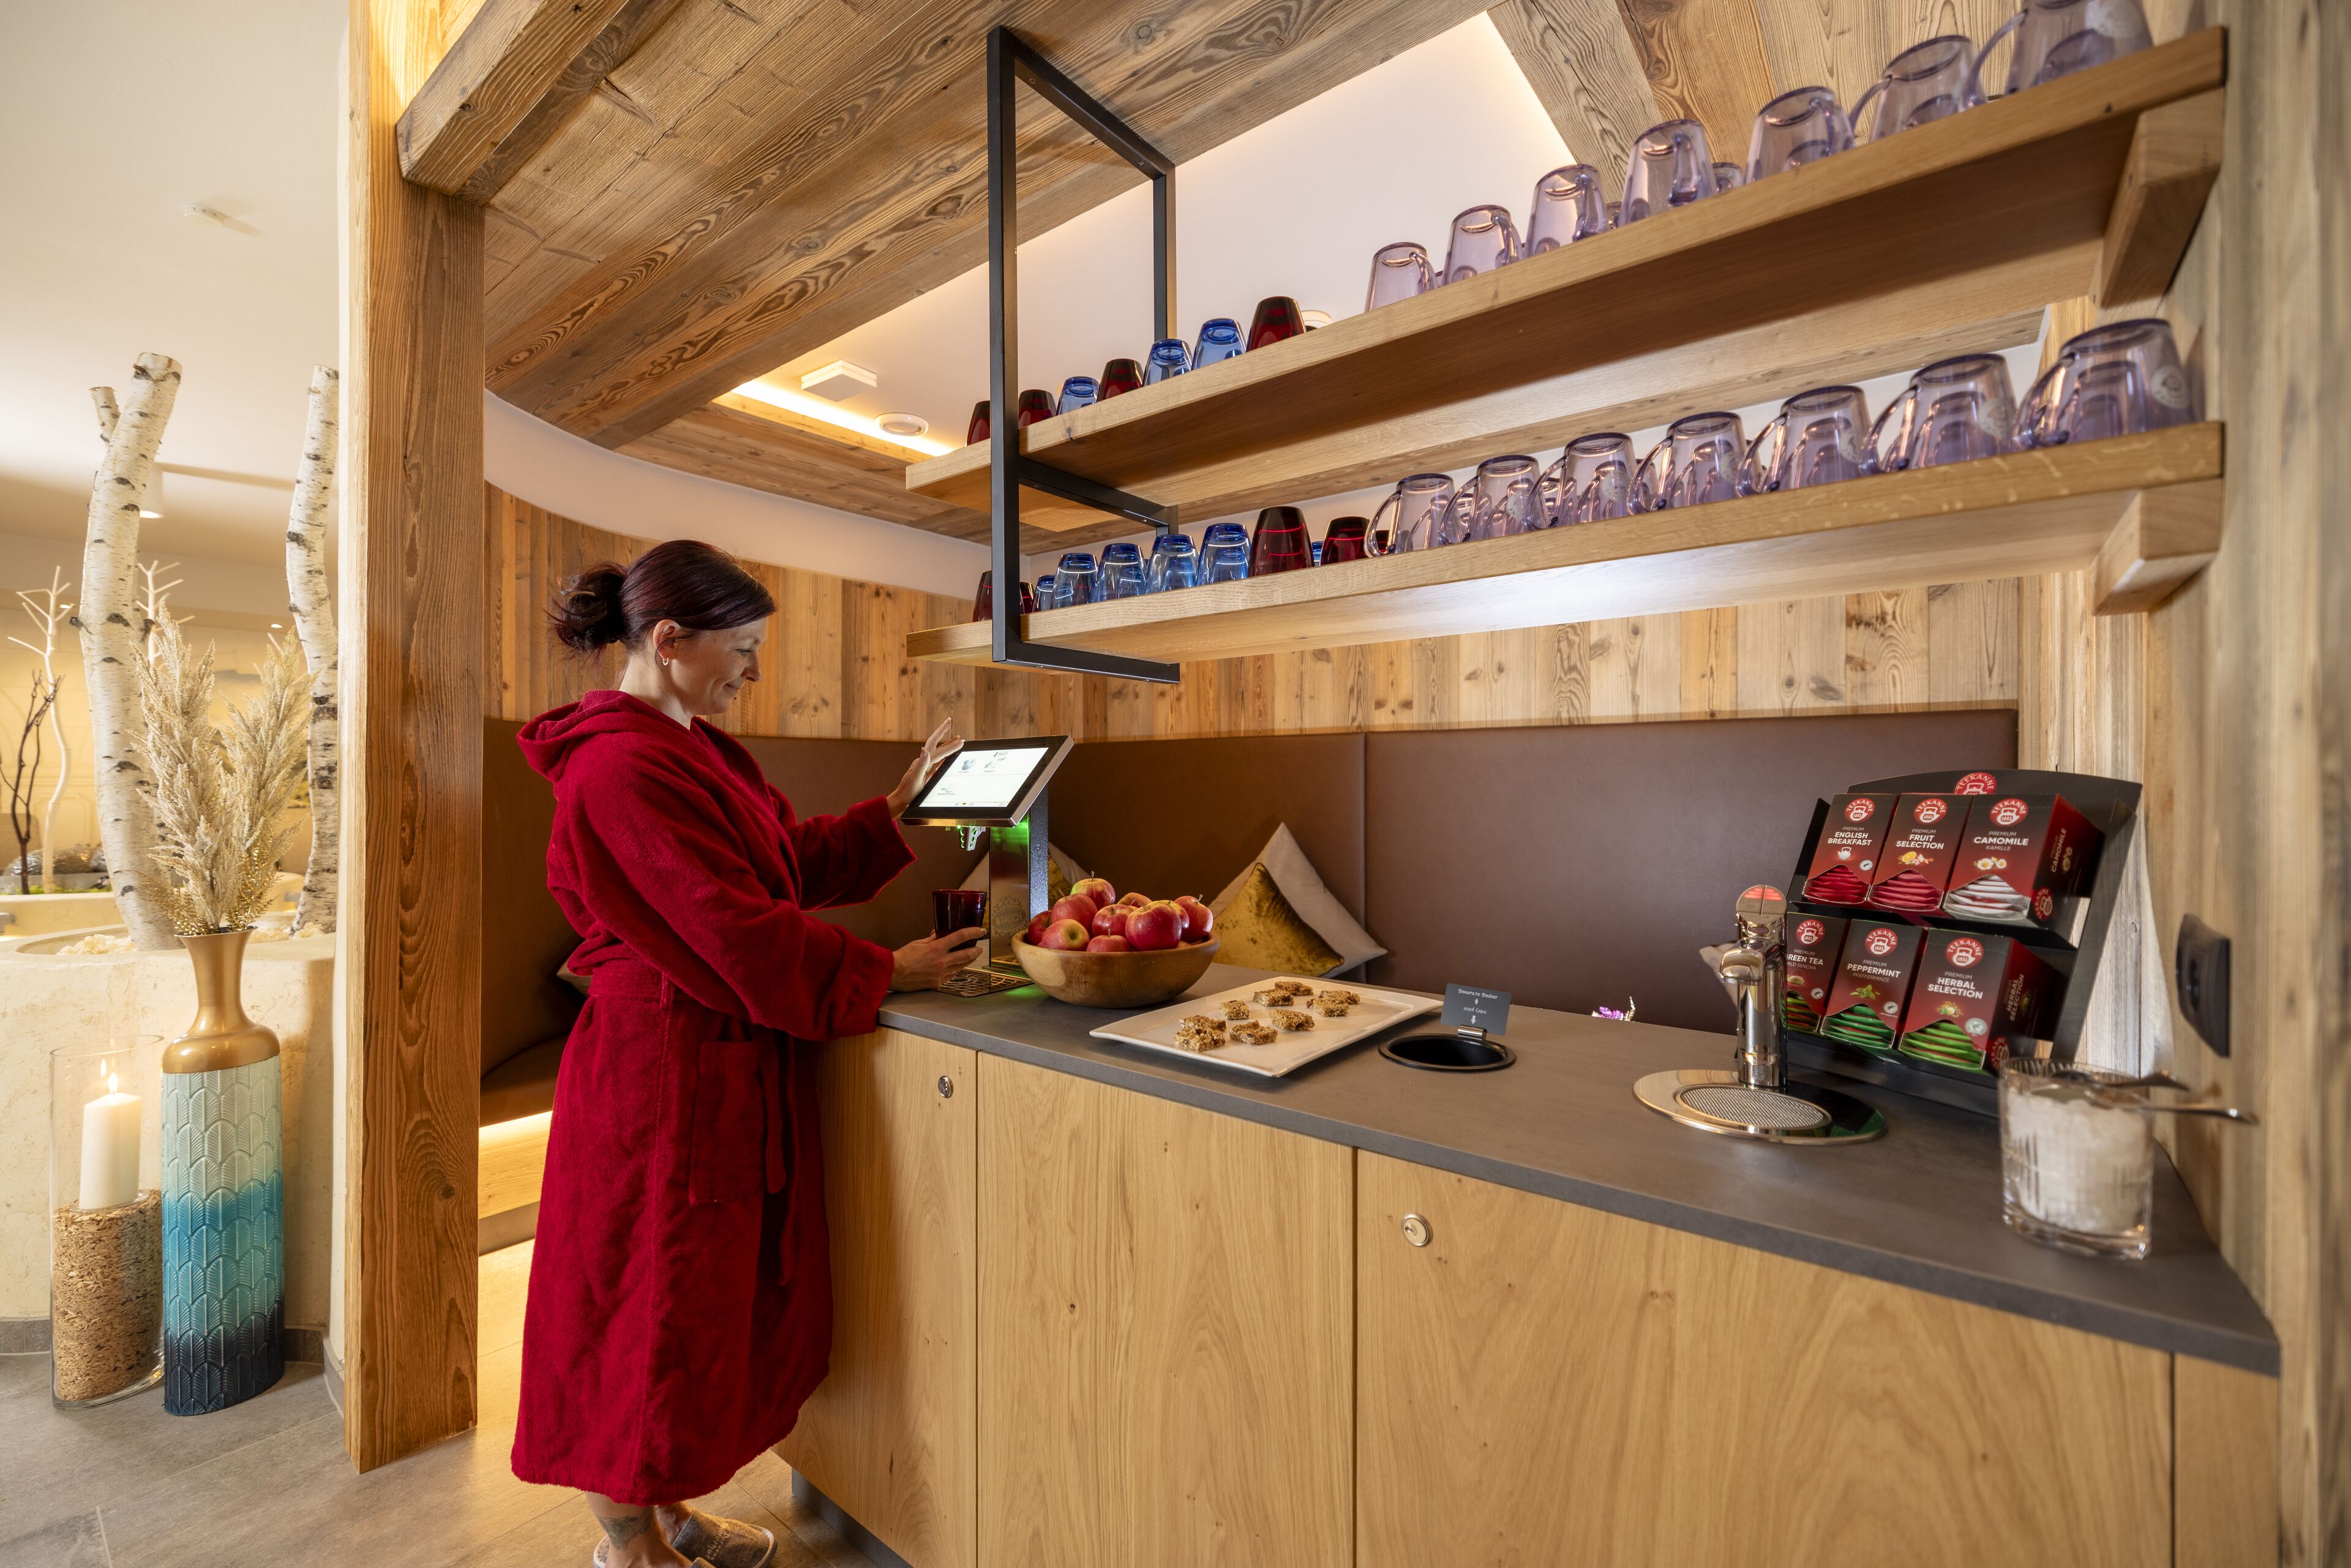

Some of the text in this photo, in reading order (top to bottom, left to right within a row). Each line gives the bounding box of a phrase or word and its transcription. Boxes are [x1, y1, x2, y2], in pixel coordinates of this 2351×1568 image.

[1957, 773, 1994, 790] TEEKANNE
[1847, 800, 1873, 812] TEEKANNE
[1916, 800, 1946, 813] TEEKANNE
[1992, 800, 2027, 815] TEEKANNE
[1895, 841, 1944, 850] SELECTION
[1974, 836, 2029, 846] CAMOMILE
[2052, 828, 2067, 872] CAMOMILE
[1798, 921, 1824, 936] TEEKANNE
[1866, 931, 1897, 946] TEEKANNE
[1948, 940, 1982, 956] TEEKANNE
[1809, 957, 1823, 966] TEA
[1847, 963, 1901, 978] PEPPERMINT
[1853, 972, 1890, 983] PFEFFERMINZE
[1938, 977, 1976, 990] HERBAL
[1928, 984, 1983, 999] SELECTION
[2007, 979, 2019, 1012] HERBAL
[2009, 974, 2025, 1022] SELECTION
